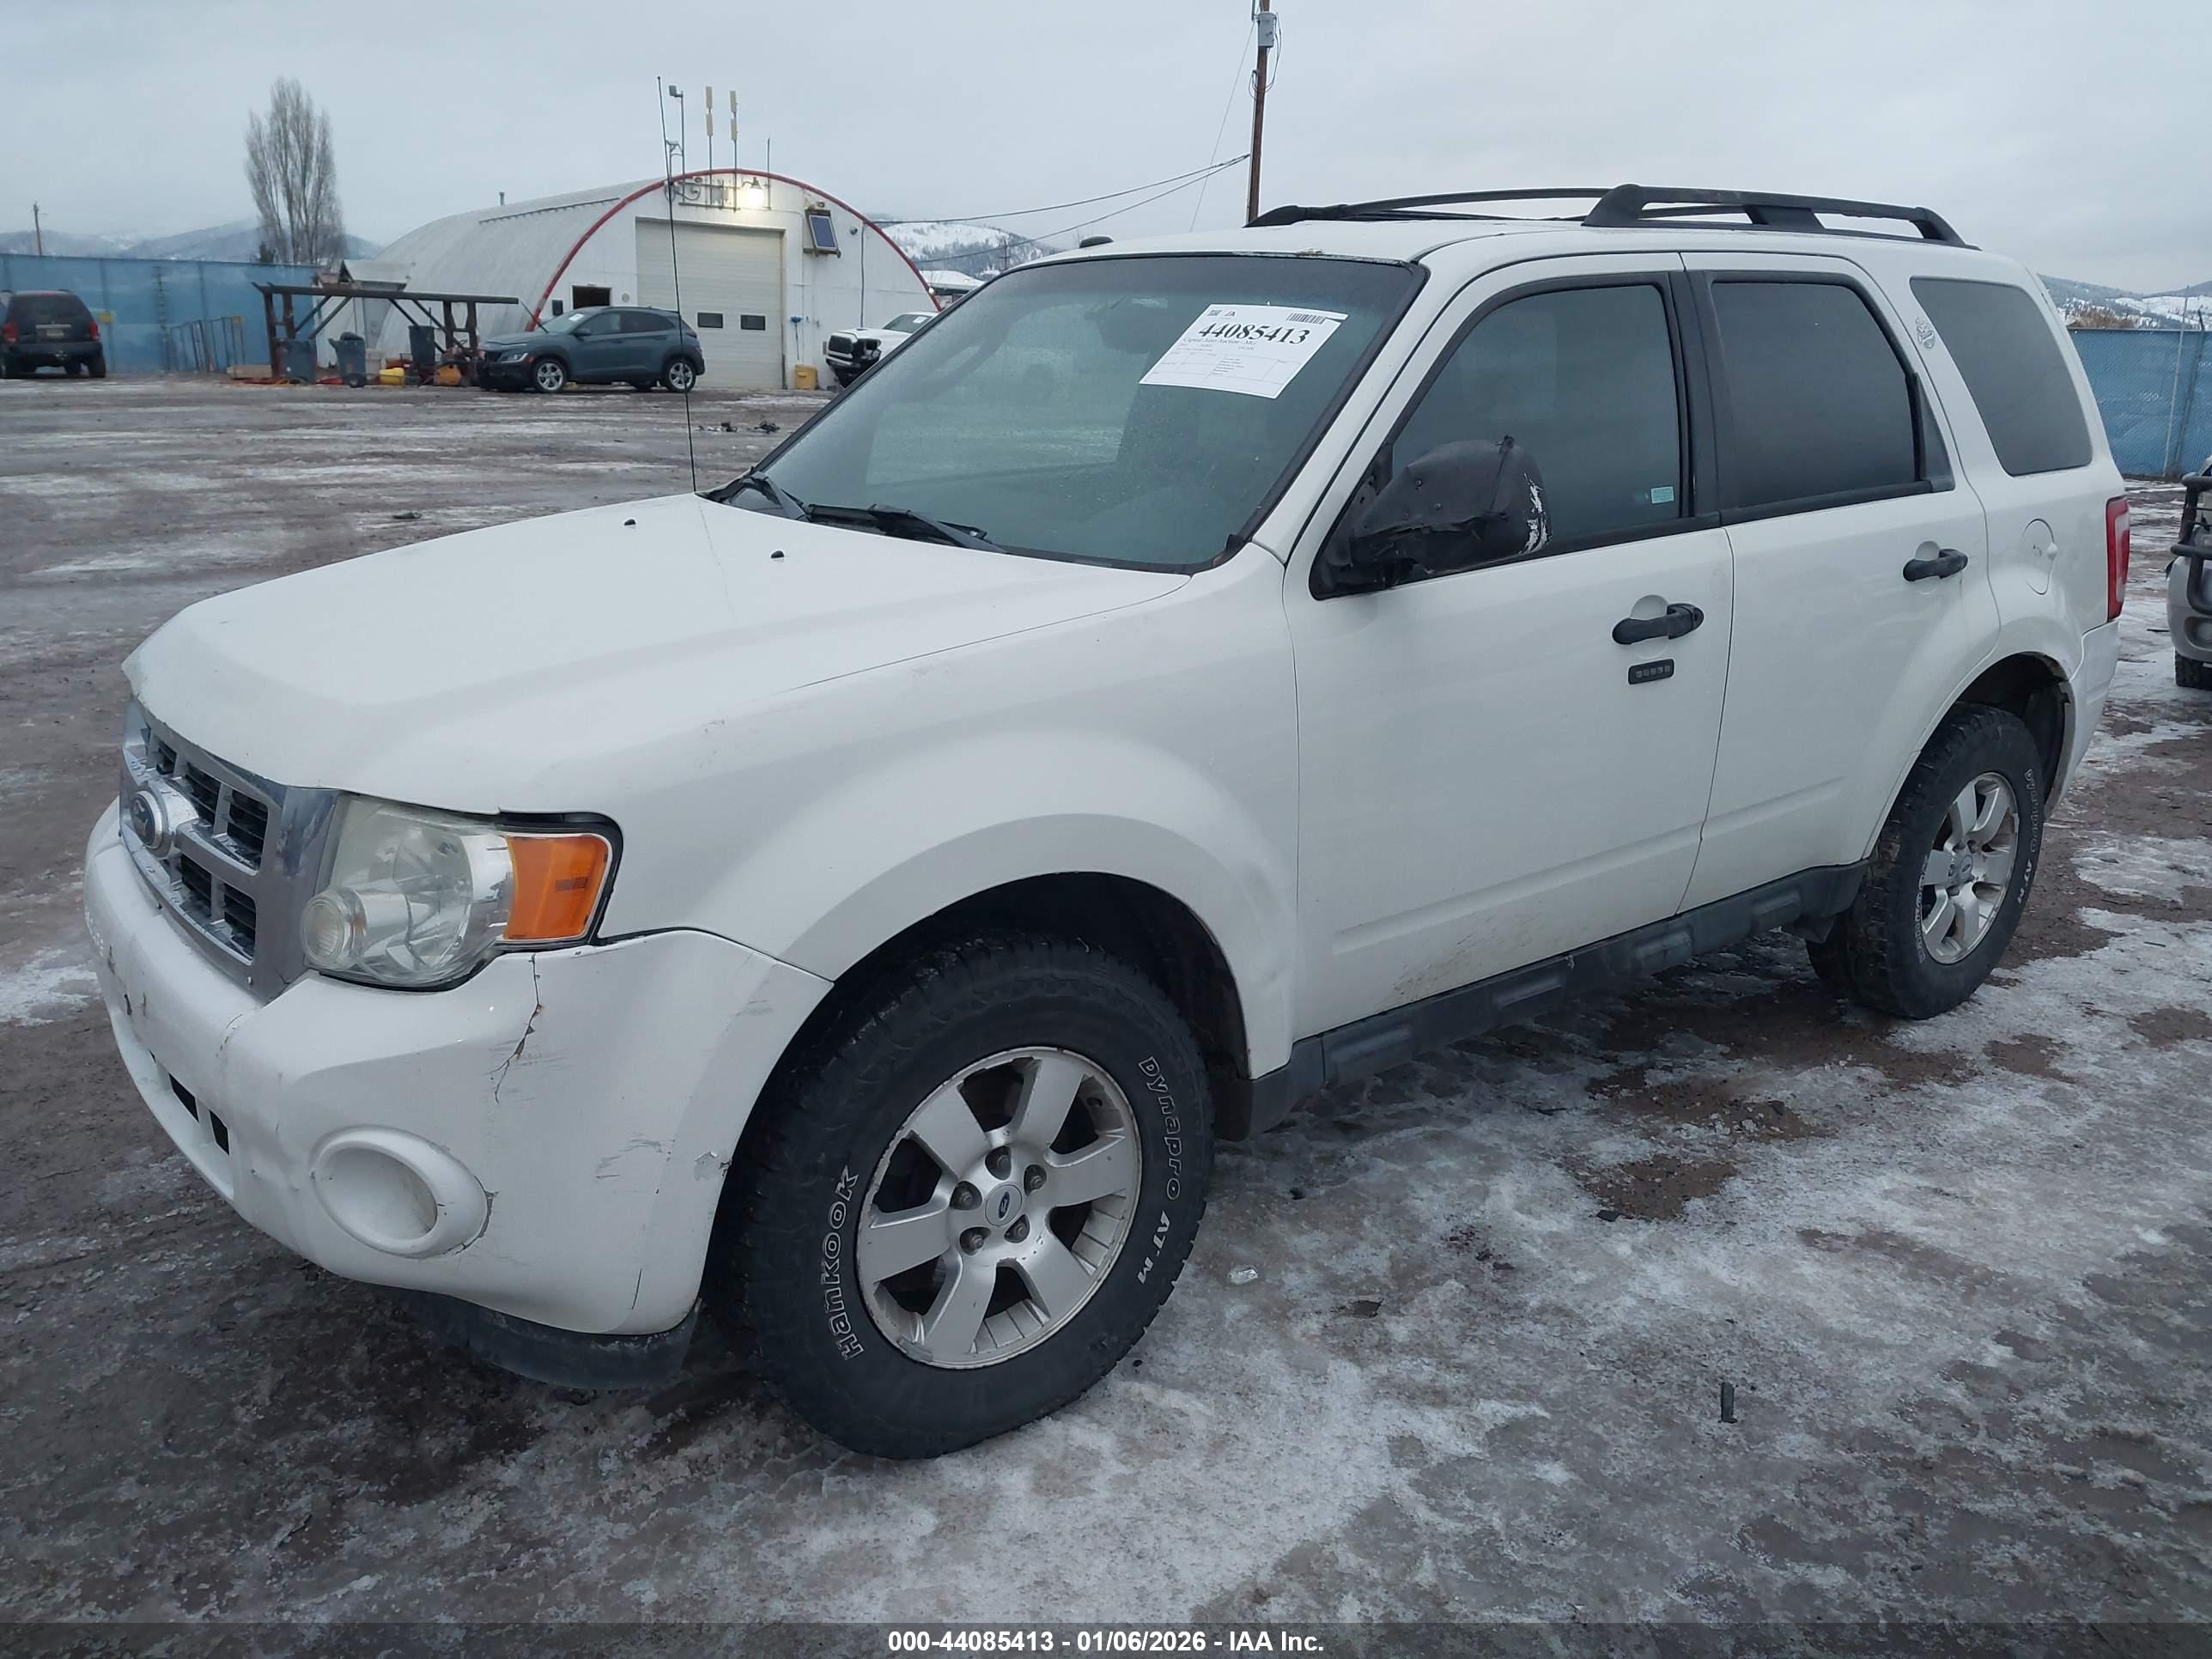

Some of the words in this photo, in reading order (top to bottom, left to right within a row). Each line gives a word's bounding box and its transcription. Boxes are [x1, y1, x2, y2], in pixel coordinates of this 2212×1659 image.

[1198, 322, 1311, 344] 44085413
[1137, 1055, 1184, 1200] Dynapro
[821, 1164, 865, 1361] Hankook
